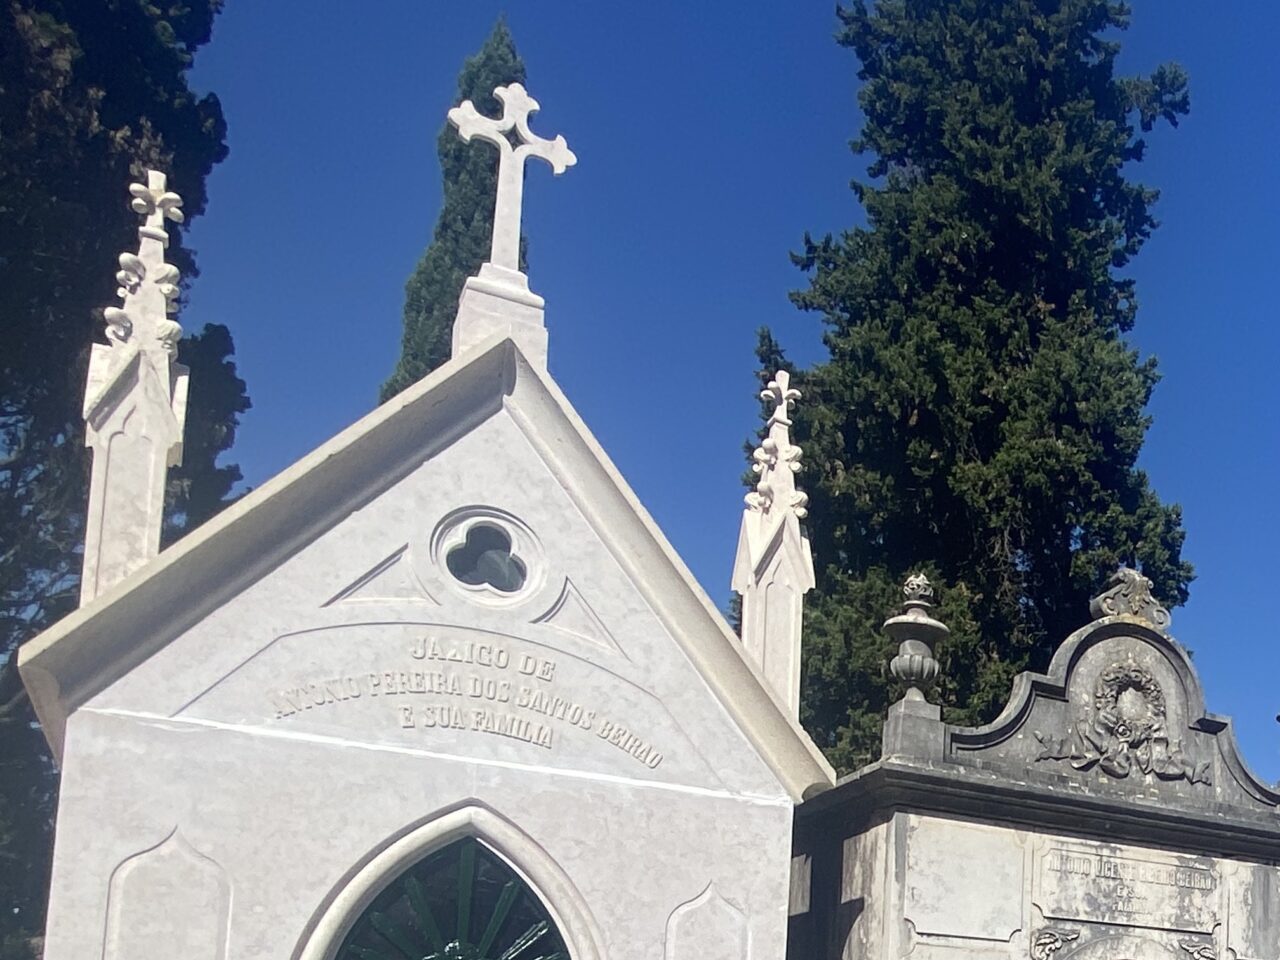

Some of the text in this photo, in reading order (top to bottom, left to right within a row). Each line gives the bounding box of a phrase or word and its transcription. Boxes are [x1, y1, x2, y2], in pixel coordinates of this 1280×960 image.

[412, 635, 556, 682] JAZIGO DE
[367, 671, 463, 697] PEREIRA
[469, 674, 511, 703] DOS
[517, 685, 597, 731] SANTOS
[400, 704, 553, 749] E SUA FAMILIA
